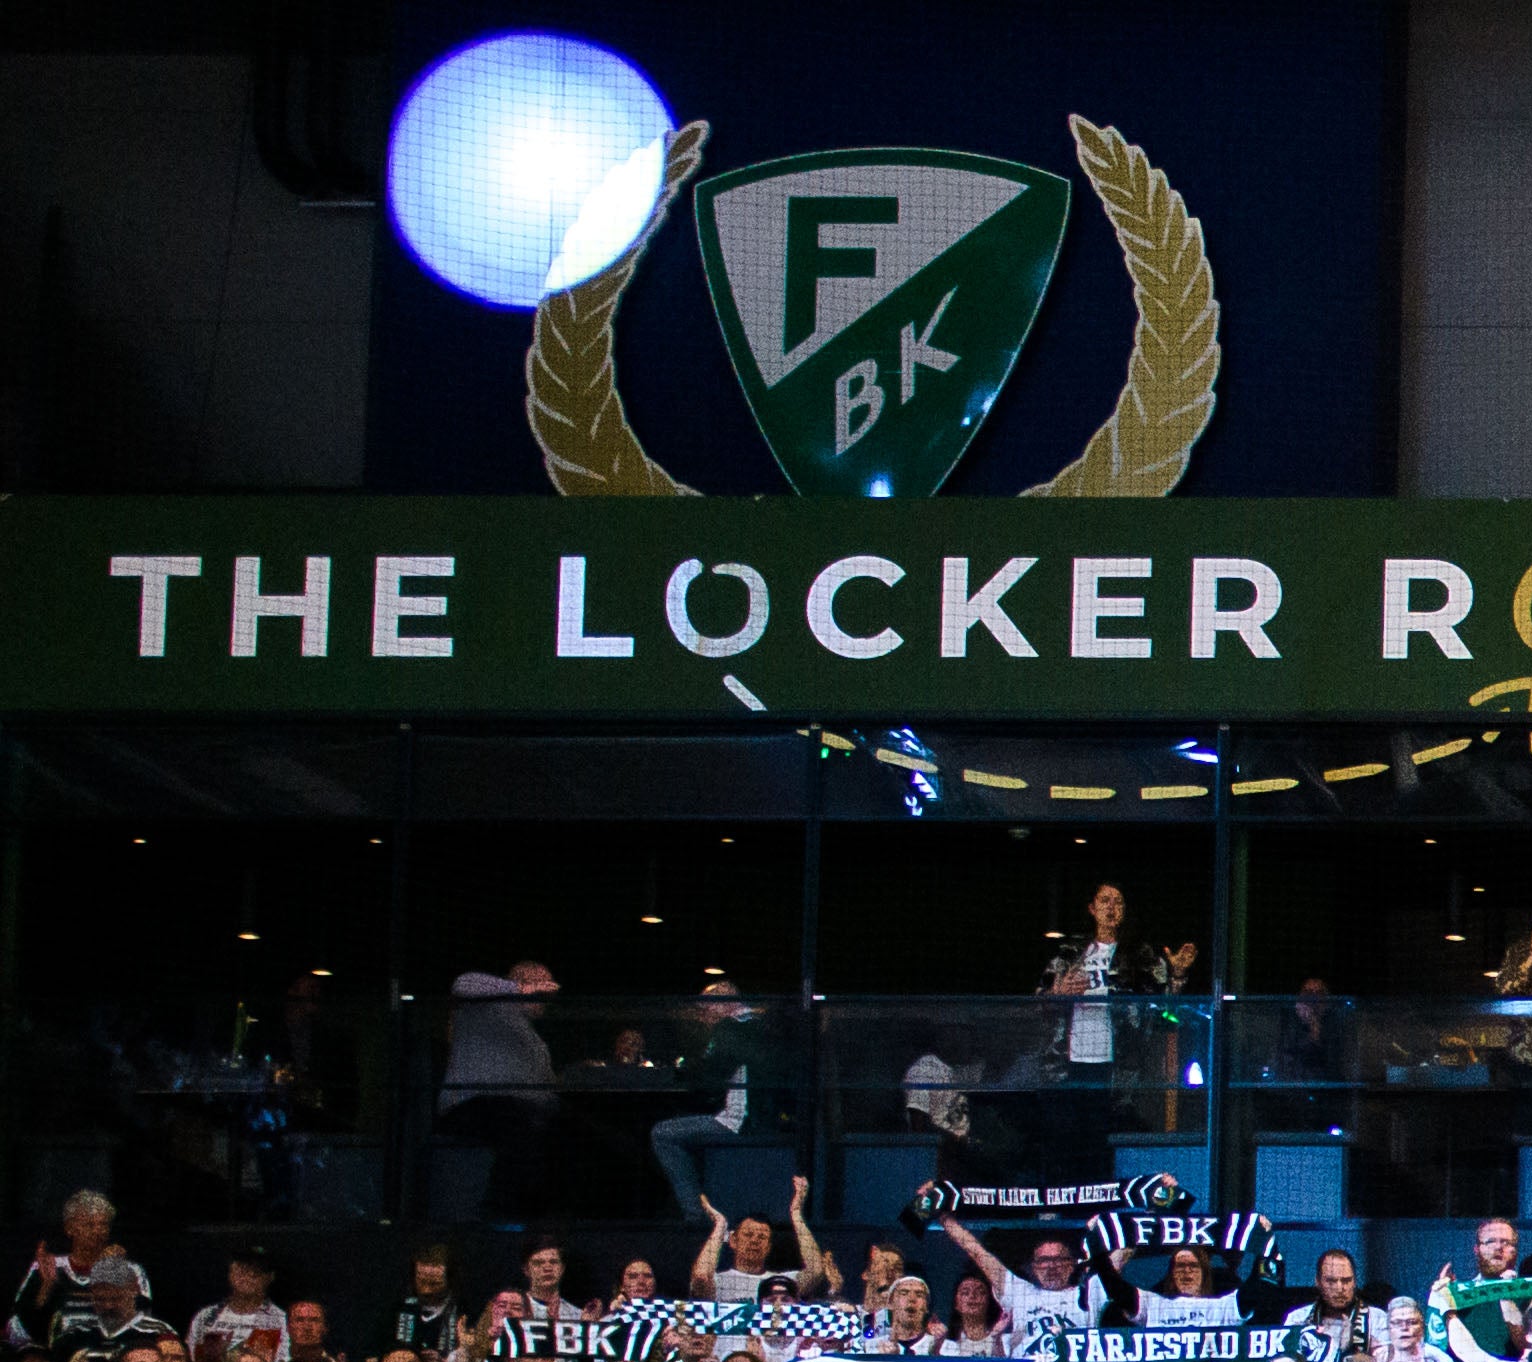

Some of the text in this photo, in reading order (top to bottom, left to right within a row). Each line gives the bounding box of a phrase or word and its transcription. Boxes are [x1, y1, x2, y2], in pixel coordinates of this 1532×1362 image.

[833, 290, 962, 460] BK
[110, 556, 456, 661] THE
[559, 556, 1282, 661] LOCKER
[1133, 1216, 1218, 1246] FBK
[524, 1319, 620, 1356] FBK
[1064, 1328, 1292, 1362] FÄRJESTAD BK
